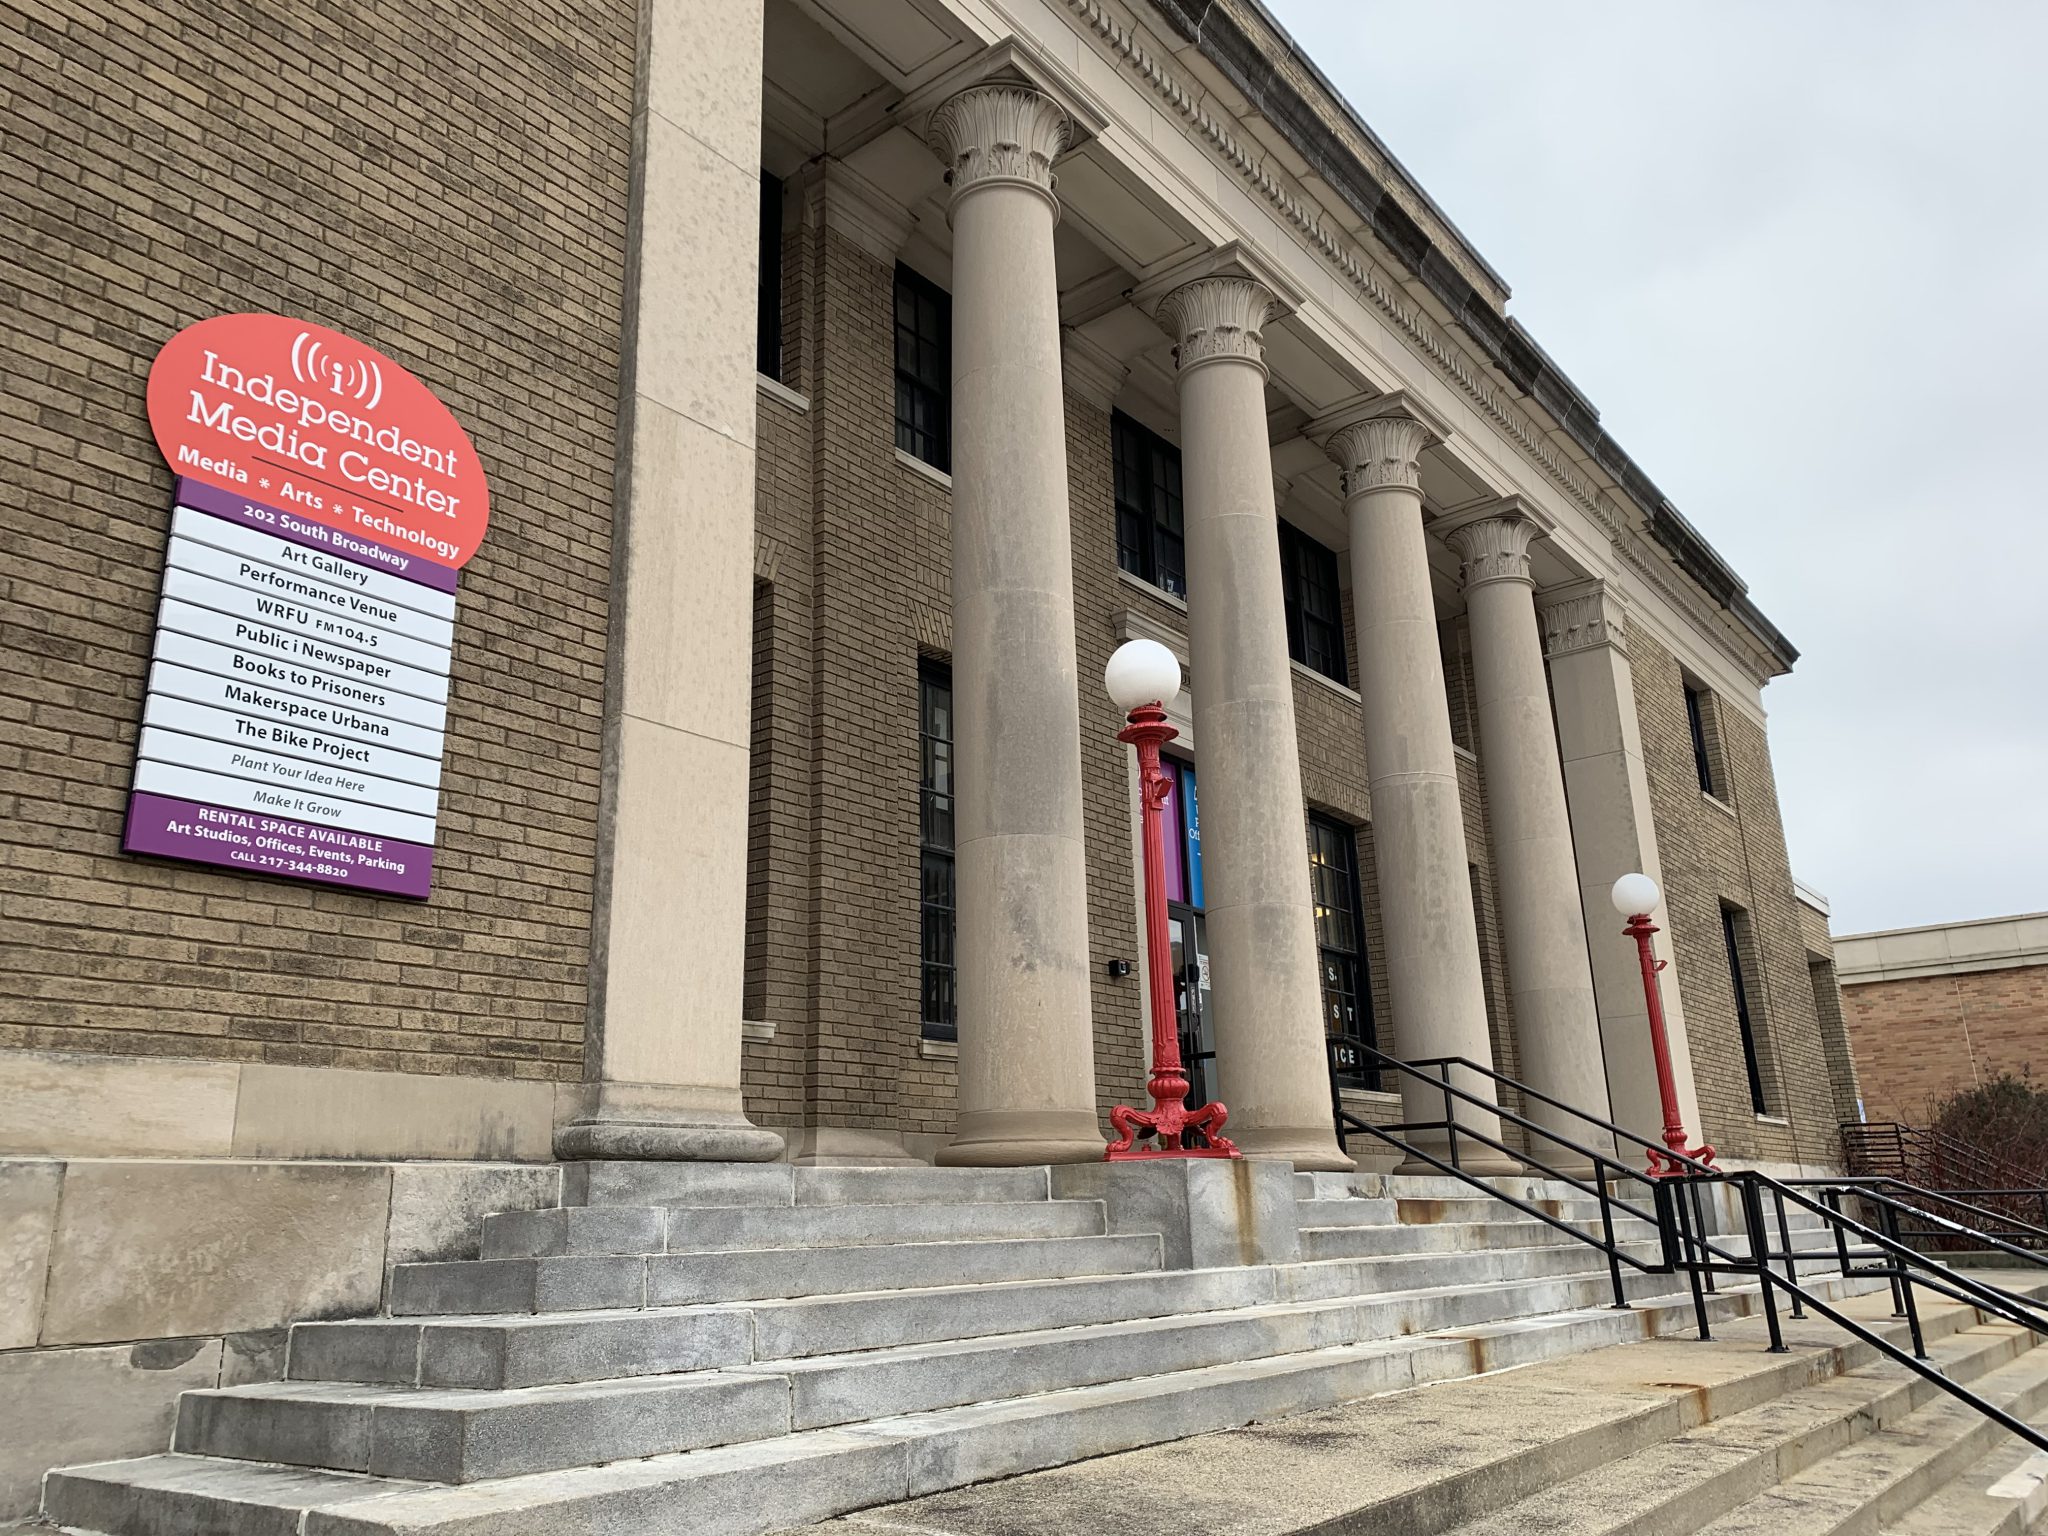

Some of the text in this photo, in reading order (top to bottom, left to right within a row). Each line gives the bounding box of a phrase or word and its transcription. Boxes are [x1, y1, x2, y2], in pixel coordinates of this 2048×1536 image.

[200, 350, 457, 478] Independent
[186, 391, 460, 518] Media Center
[178, 445, 460, 560] Media Arts Technology
[243, 505, 409, 571] 202 South Broadway
[281, 545, 369, 586] Art Gallery
[239, 563, 397, 623] Performance Venue
[256, 598, 309, 625] WRFU
[236, 623, 391, 679] Public i Newspaper
[232, 654, 385, 706] Books to Prisoners
[225, 684, 389, 736] Makerspace Urbana
[235, 719, 370, 763] The Bike Project
[231, 754, 365, 792] Plant Your Idea Here
[198, 808, 383, 852] RENTAL SPACE AVAILABLE
[253, 790, 342, 818] Make It Grow
[166, 819, 406, 875] Art Studios, Offices, Events, Parking
[230, 850, 348, 878] CALL 217-344-8820
